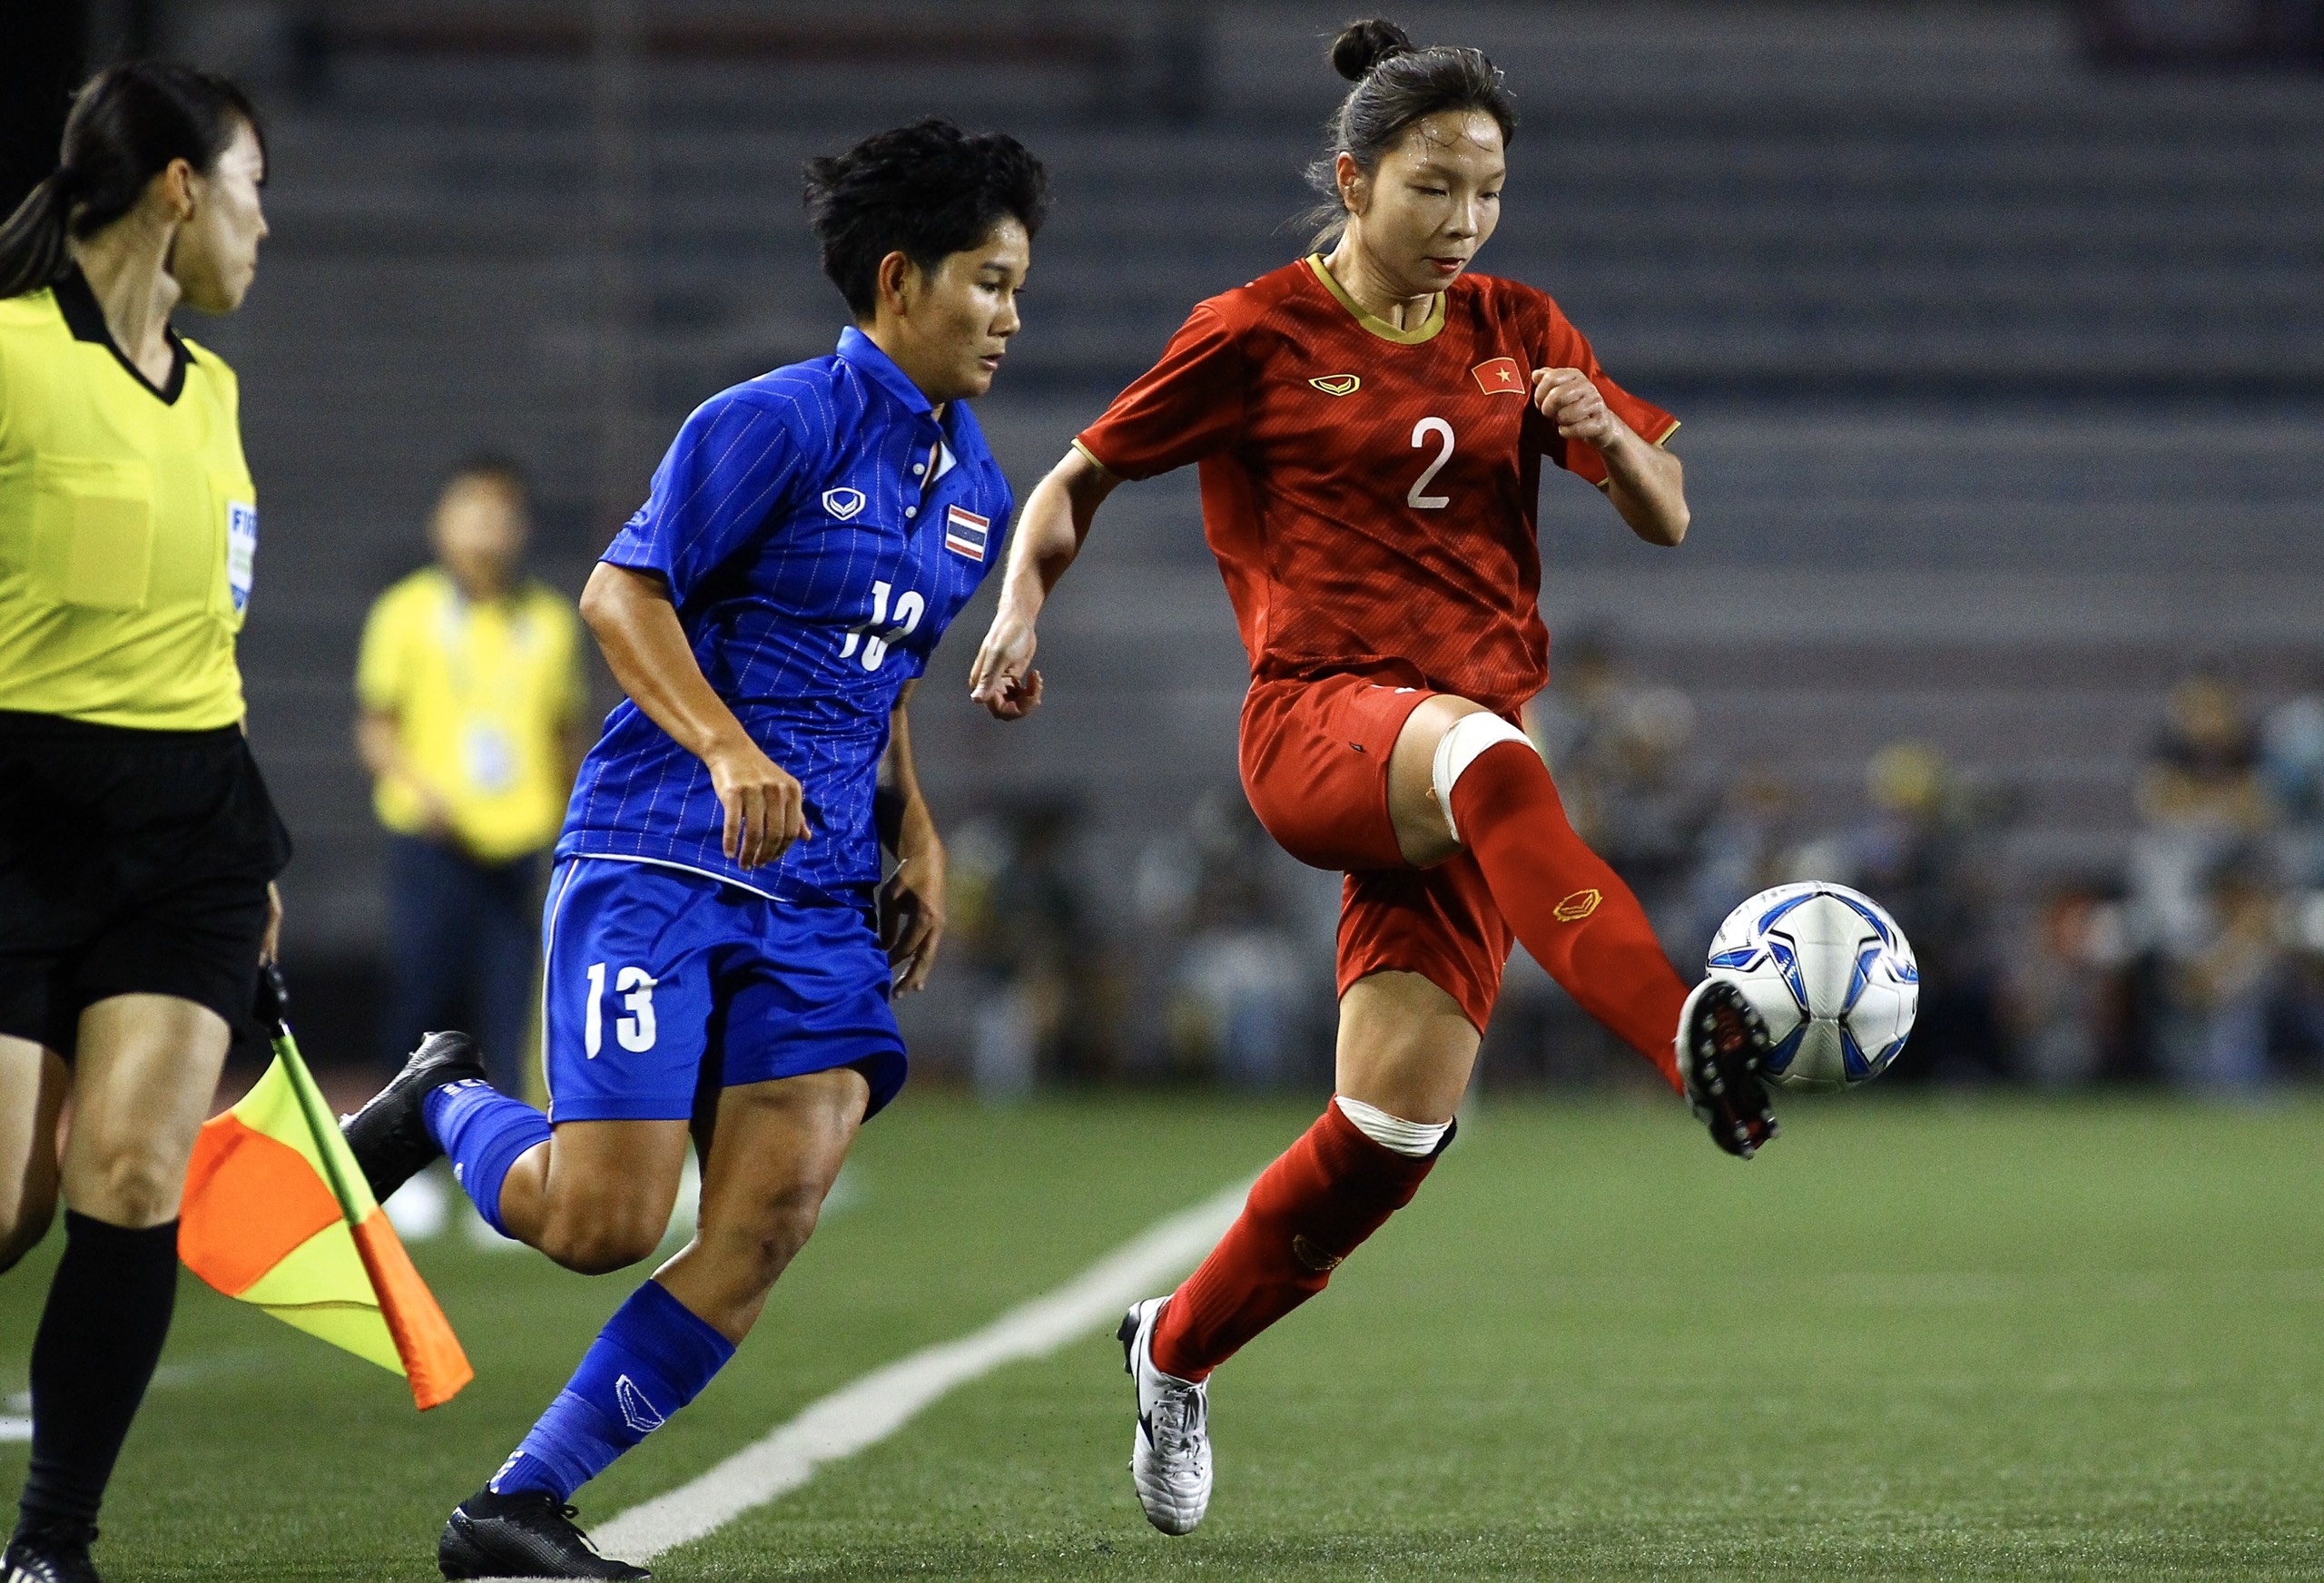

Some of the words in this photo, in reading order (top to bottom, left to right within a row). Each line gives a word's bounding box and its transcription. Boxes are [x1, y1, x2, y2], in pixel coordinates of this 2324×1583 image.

[1407, 417, 1455, 509] 2
[232, 508, 258, 538] FIF
[838, 580, 925, 672] 13
[585, 962, 658, 1060] 13
